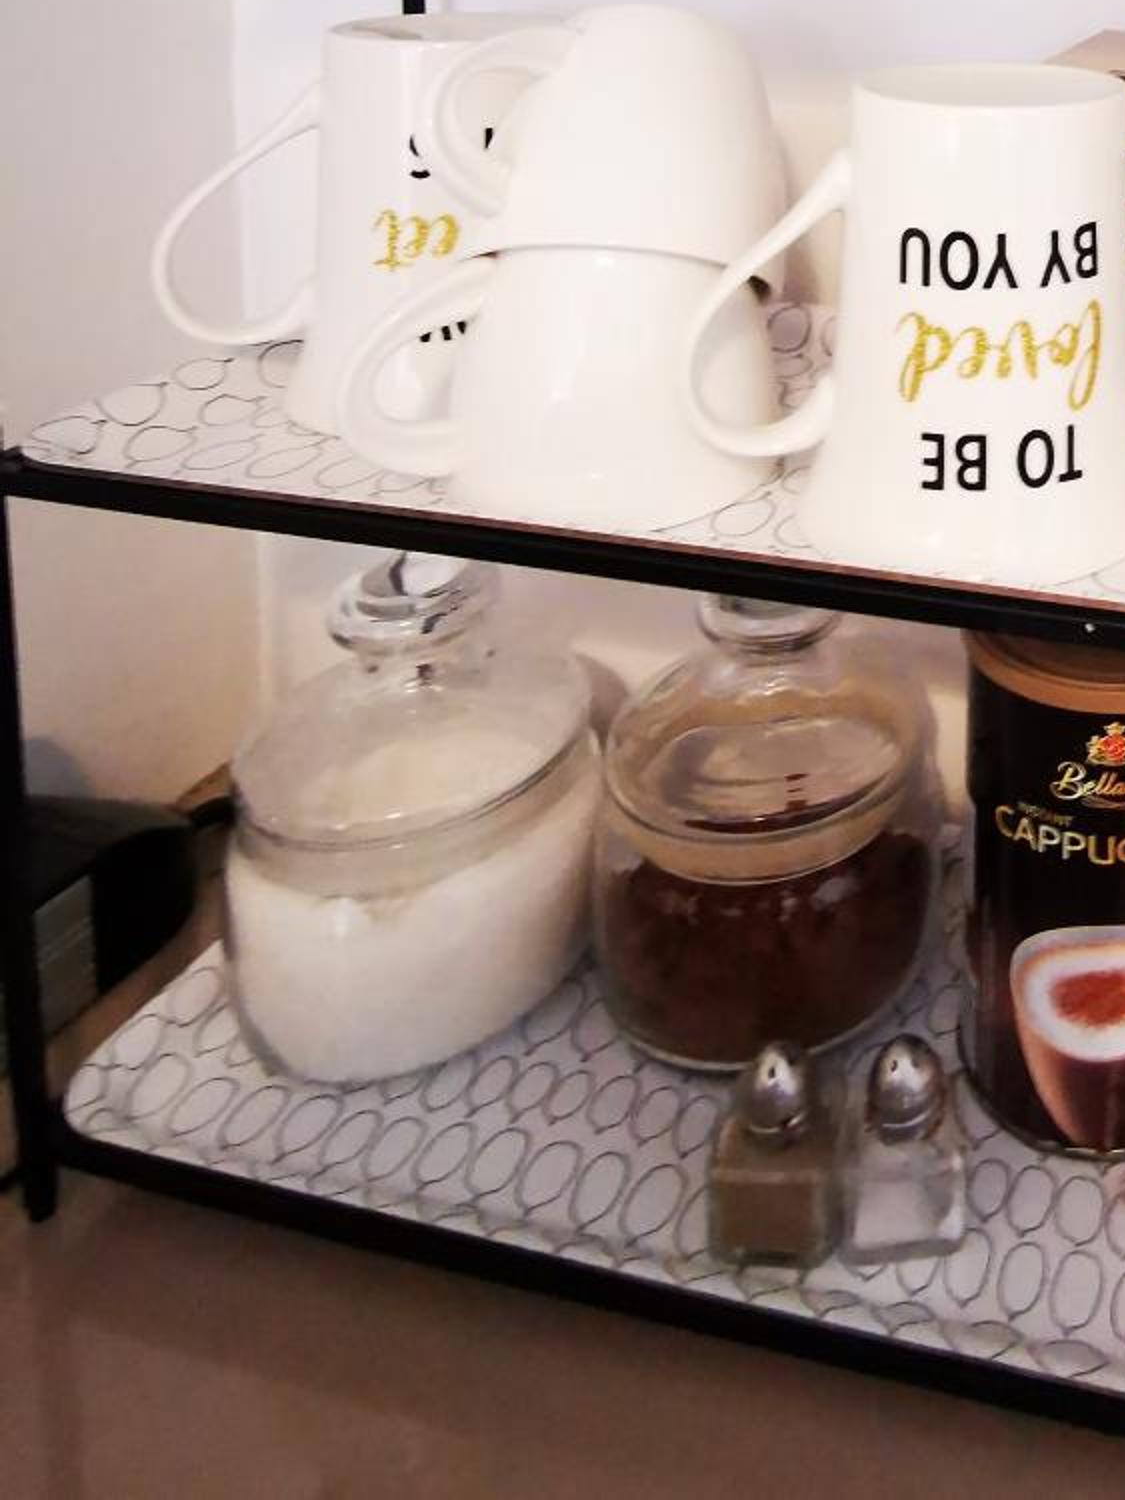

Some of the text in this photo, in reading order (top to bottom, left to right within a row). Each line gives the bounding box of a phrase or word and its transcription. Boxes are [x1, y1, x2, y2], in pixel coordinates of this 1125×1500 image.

[899, 221, 1099, 291] BY YOU
[895, 299, 1102, 411] loved
[920, 424, 1084, 491] TO BE
